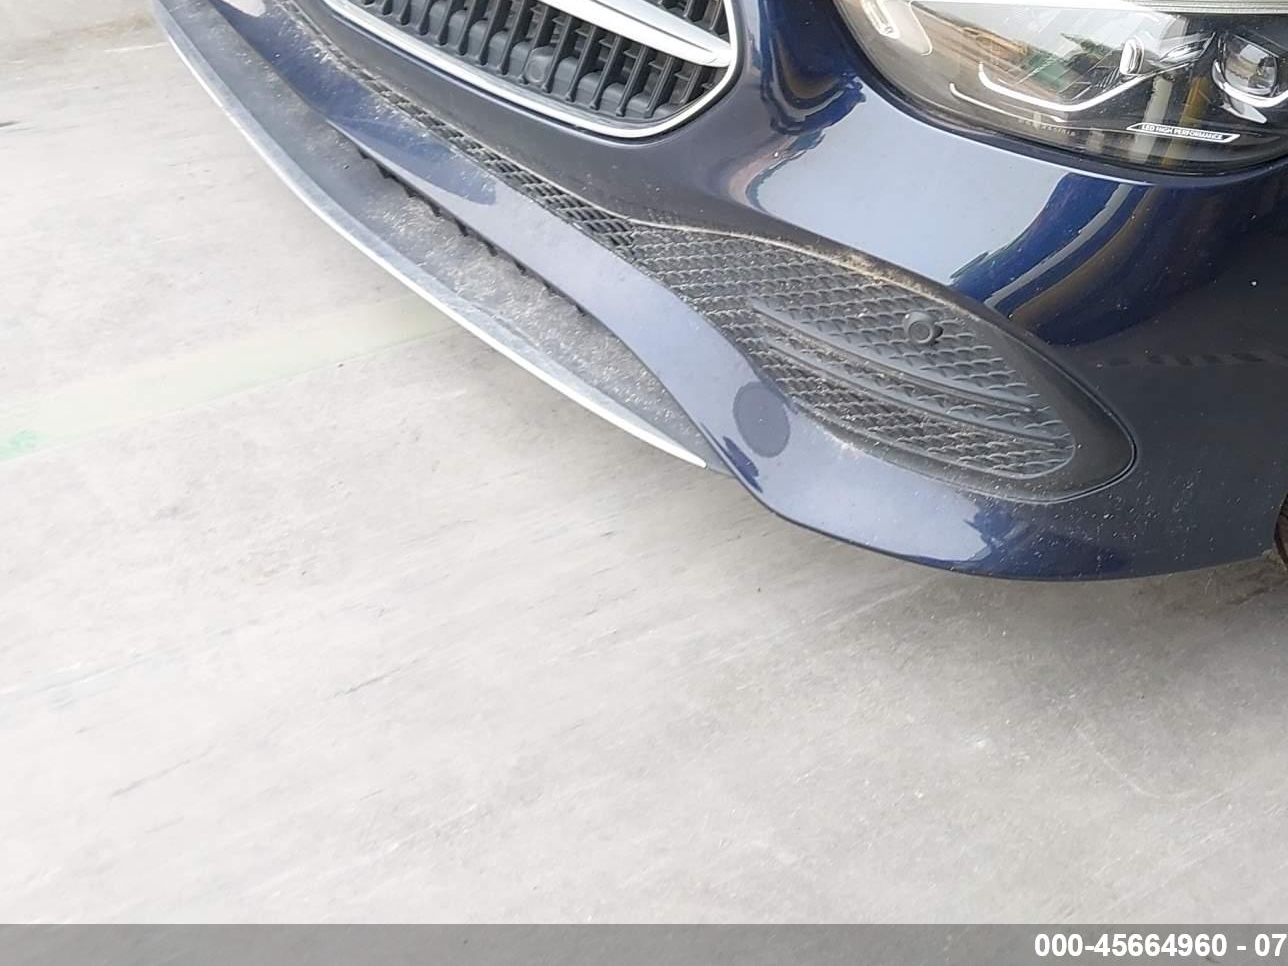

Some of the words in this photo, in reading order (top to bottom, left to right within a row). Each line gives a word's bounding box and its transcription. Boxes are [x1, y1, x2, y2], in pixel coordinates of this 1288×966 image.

[1141, 124, 1155, 132] LED
[1156, 126, 1173, 135] HIGH
[1174, 128, 1223, 140] PERFORMANCE
